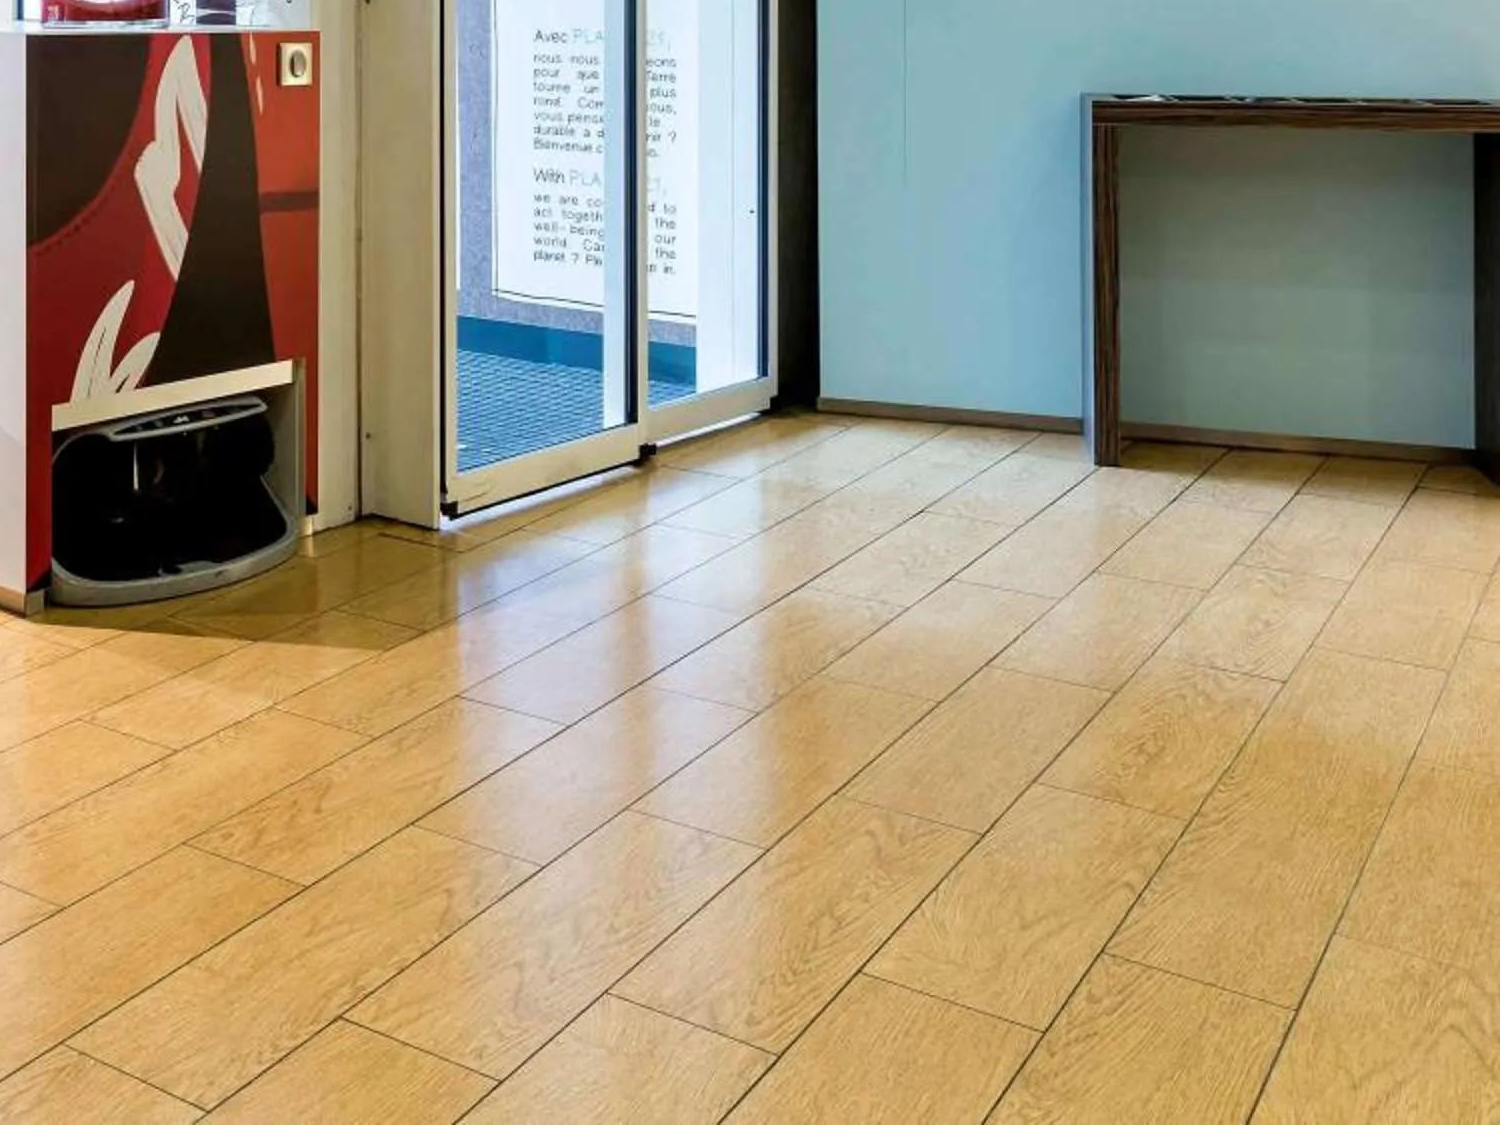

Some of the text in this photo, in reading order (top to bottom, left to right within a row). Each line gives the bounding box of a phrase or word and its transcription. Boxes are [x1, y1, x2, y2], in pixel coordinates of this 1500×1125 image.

[533, 28, 567, 44] Avec
[532, 167, 565, 184] With
[533, 194, 551, 204] we
[655, 216, 677, 230] the
